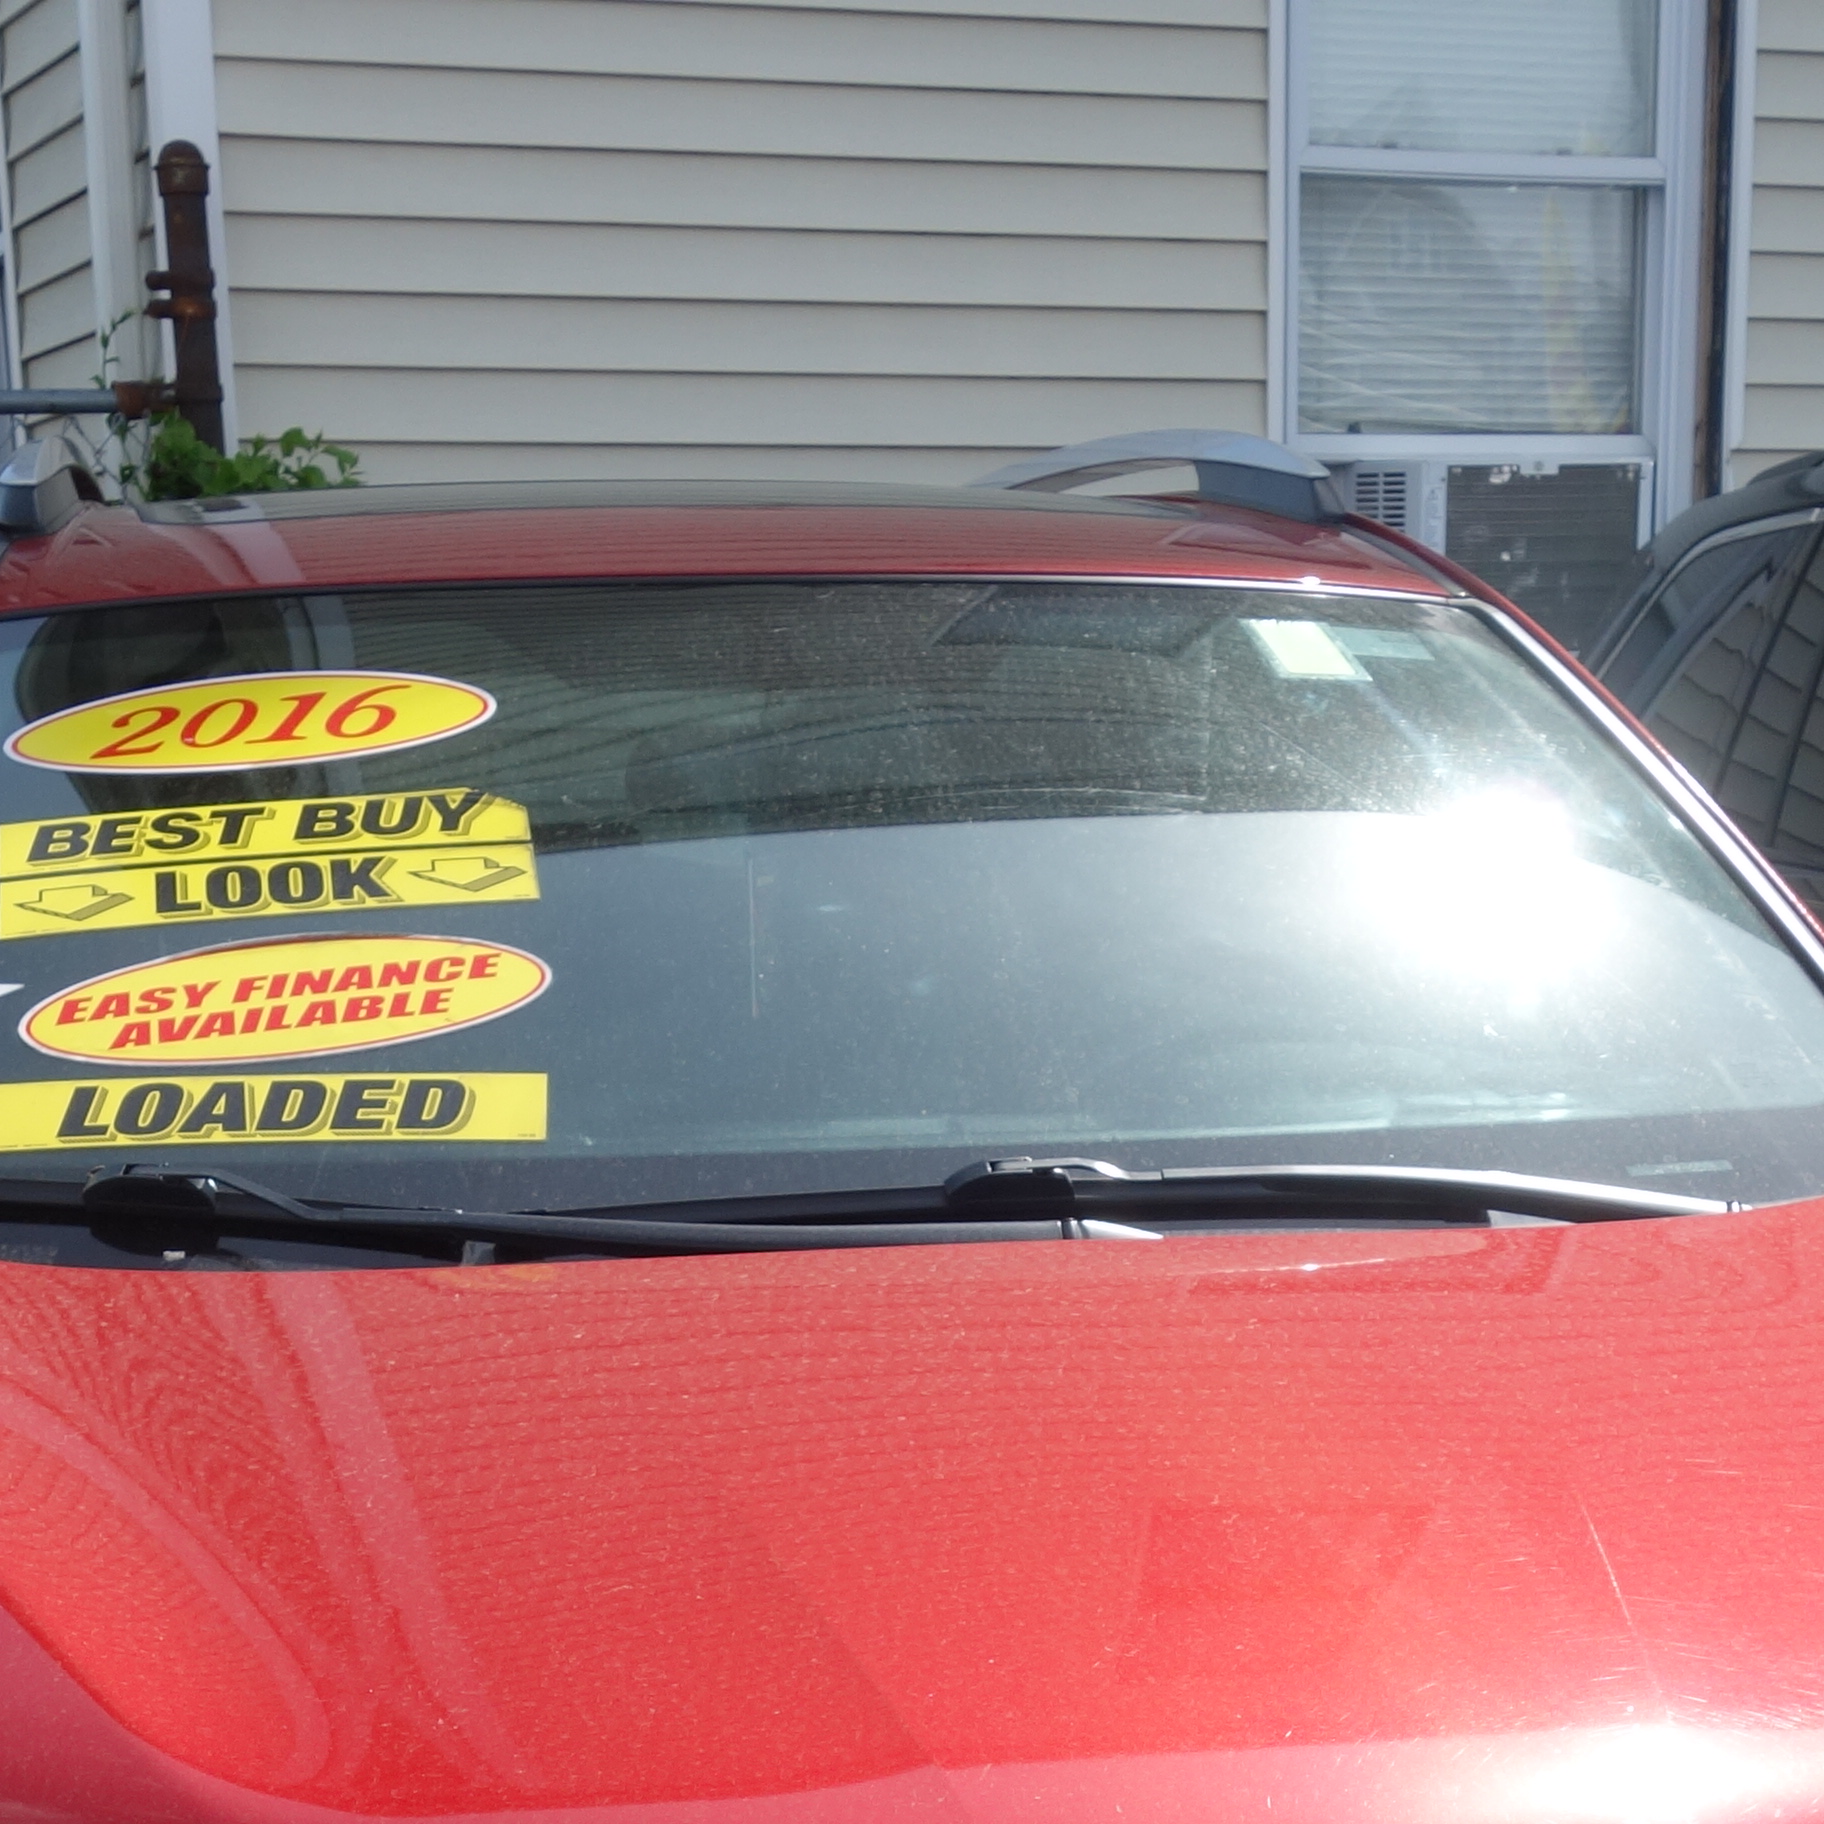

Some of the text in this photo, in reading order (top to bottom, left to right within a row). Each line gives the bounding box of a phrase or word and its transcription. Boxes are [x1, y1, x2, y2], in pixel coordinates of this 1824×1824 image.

[90, 684, 414, 760] 2016
[27, 789, 484, 865] BEST BUY
[154, 856, 392, 916] LOOK
[54, 952, 501, 1026] EASY FINANCE
[108, 988, 452, 1050] AVAILABLE
[56, 1079, 473, 1141] LOADED
